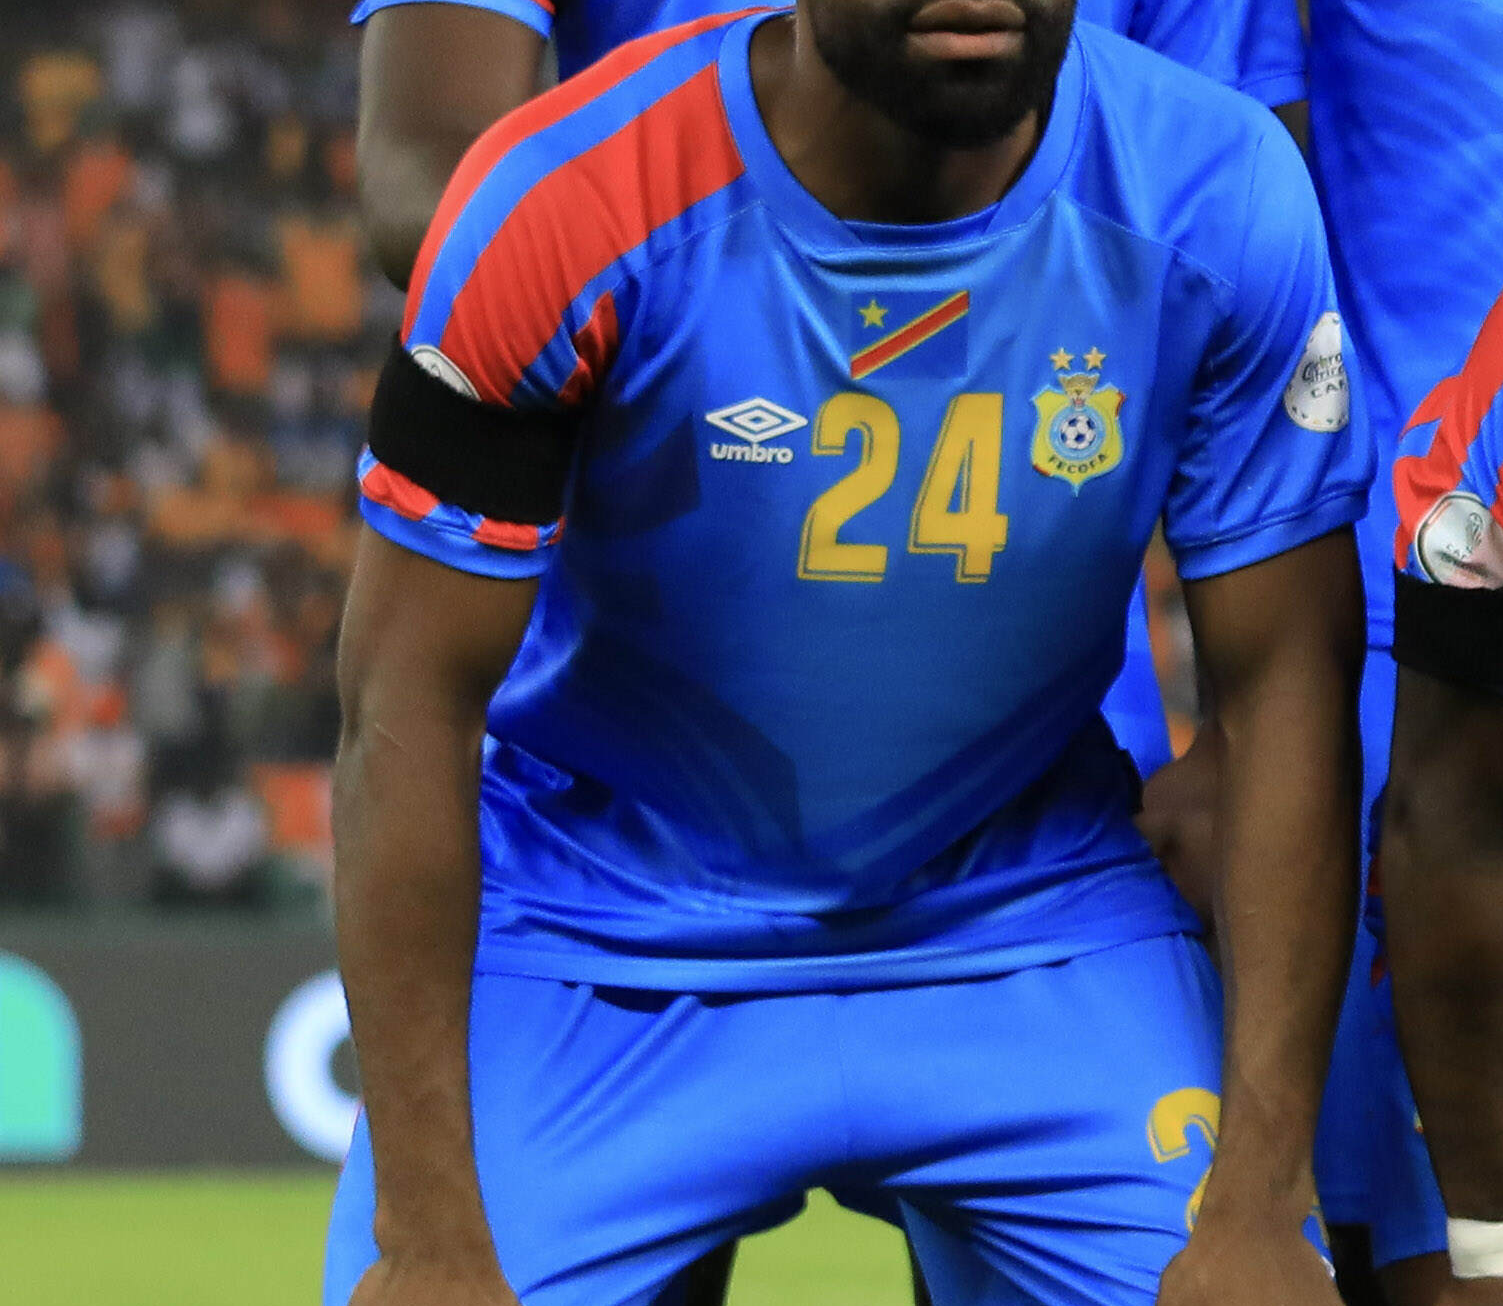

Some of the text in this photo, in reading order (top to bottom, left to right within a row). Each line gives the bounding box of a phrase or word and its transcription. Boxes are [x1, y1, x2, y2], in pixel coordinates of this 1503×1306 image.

[710, 441, 795, 465] umbro
[1047, 452, 1108, 476] FECOFA
[798, 392, 1009, 584] 24
